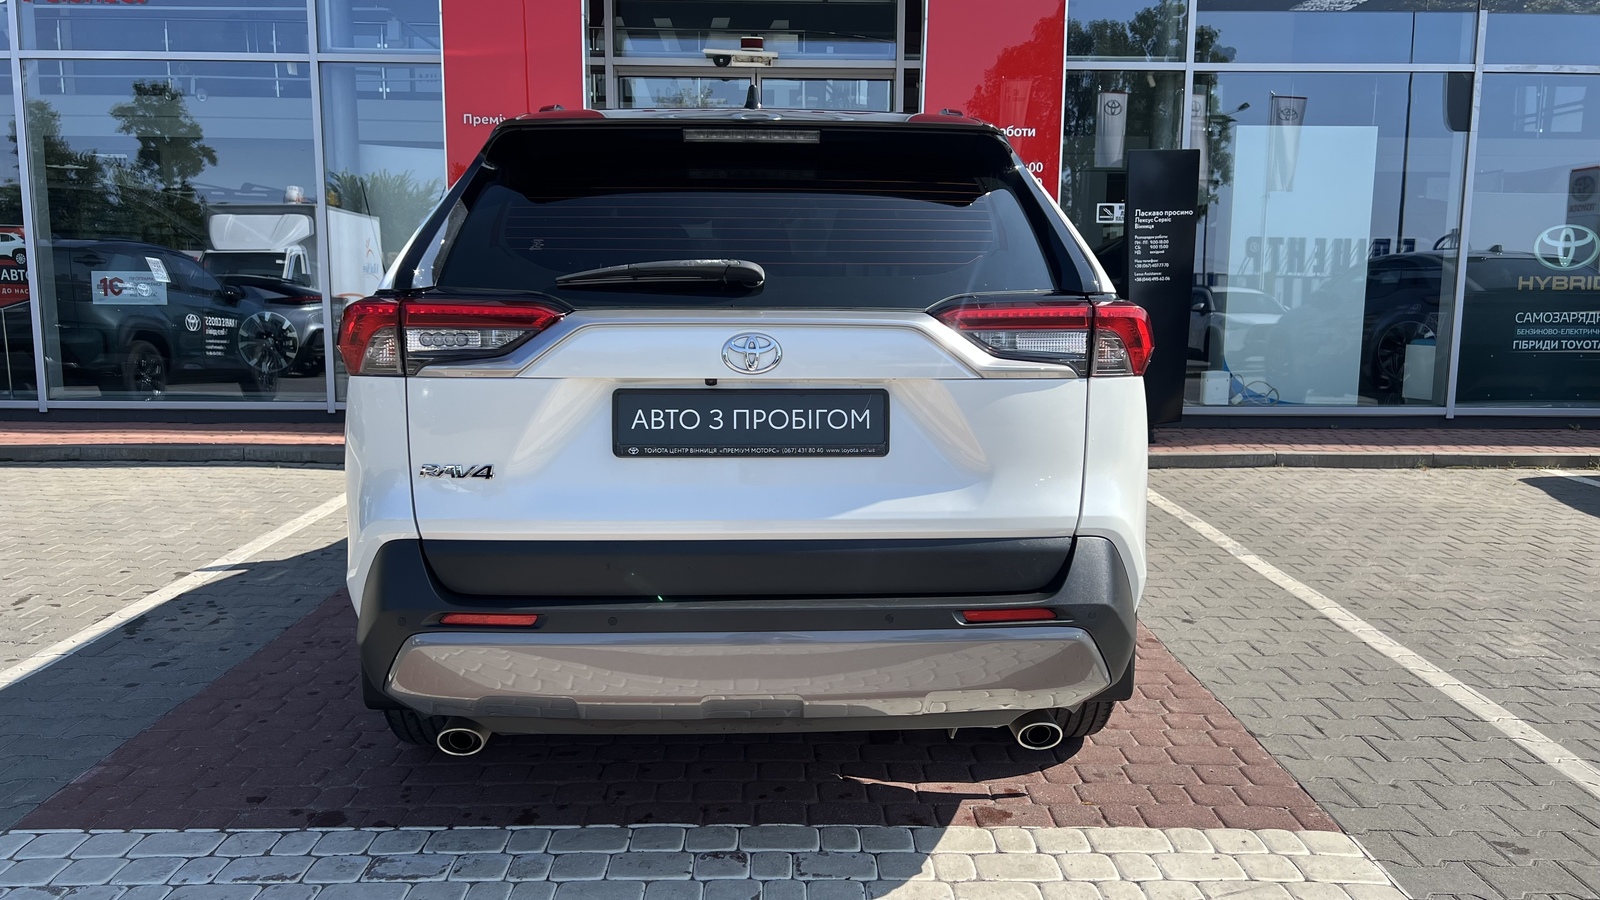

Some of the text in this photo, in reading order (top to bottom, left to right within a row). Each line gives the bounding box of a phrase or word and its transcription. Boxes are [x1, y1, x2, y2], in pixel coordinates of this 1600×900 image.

[463, 113, 506, 127] Премі
[0, 268, 29, 281] АВТ
[1513, 340, 1559, 351] ГІБРИДИ
[631, 409, 870, 430] АВТО З ПРОБІГОМ
[644, 446, 669, 454] ТОЙОТА
[669, 447, 689, 455] ЦЕНТР
[689, 447, 718, 455] ВІННИЦЯ
[781, 447, 797, 455] (067)
[419, 463, 496, 480] RAV4
